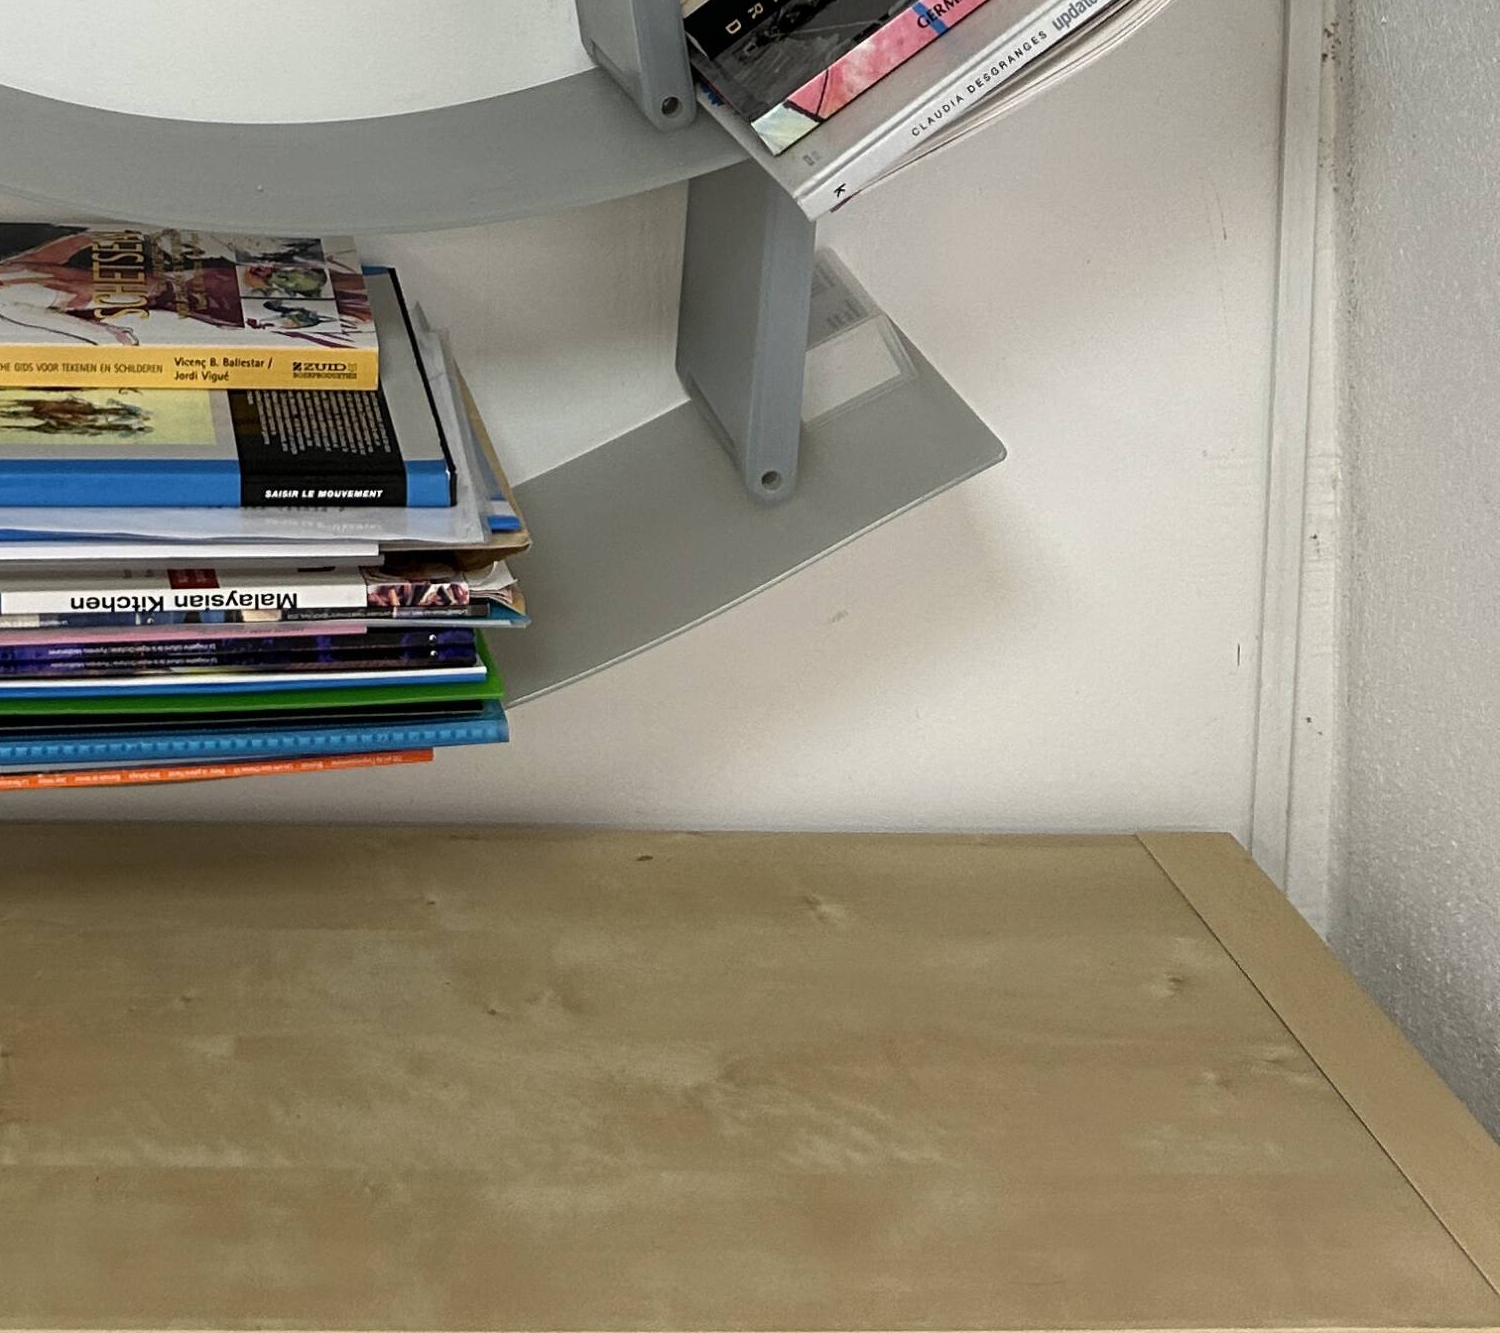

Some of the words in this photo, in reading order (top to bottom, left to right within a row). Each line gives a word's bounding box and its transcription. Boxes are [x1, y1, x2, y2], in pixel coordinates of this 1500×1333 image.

[908, 90, 966, 139] CLAUDIA
[964, 27, 1049, 96] DESGRANGES
[13, 361, 34, 372] GIDS
[35, 361, 59, 372] VOOR
[61, 362, 97, 374] TEKENEN
[99, 362, 111, 374] EN
[113, 362, 164, 375] SCHILDEREN
[173, 355, 206, 369] Vicenç
[208, 357, 220, 368] B.
[222, 356, 264, 370] Ballestar
[301, 361, 347, 373] ZUID
[173, 368, 198, 382] Jordi
[200, 368, 230, 384] Vigué
[264, 489, 298, 498] SAISIR
[301, 489, 314, 498] LE
[317, 489, 383, 498] MOUVEMENT
[69, 594, 164, 613] Kitchen
[173, 589, 298, 611] Malaysian
